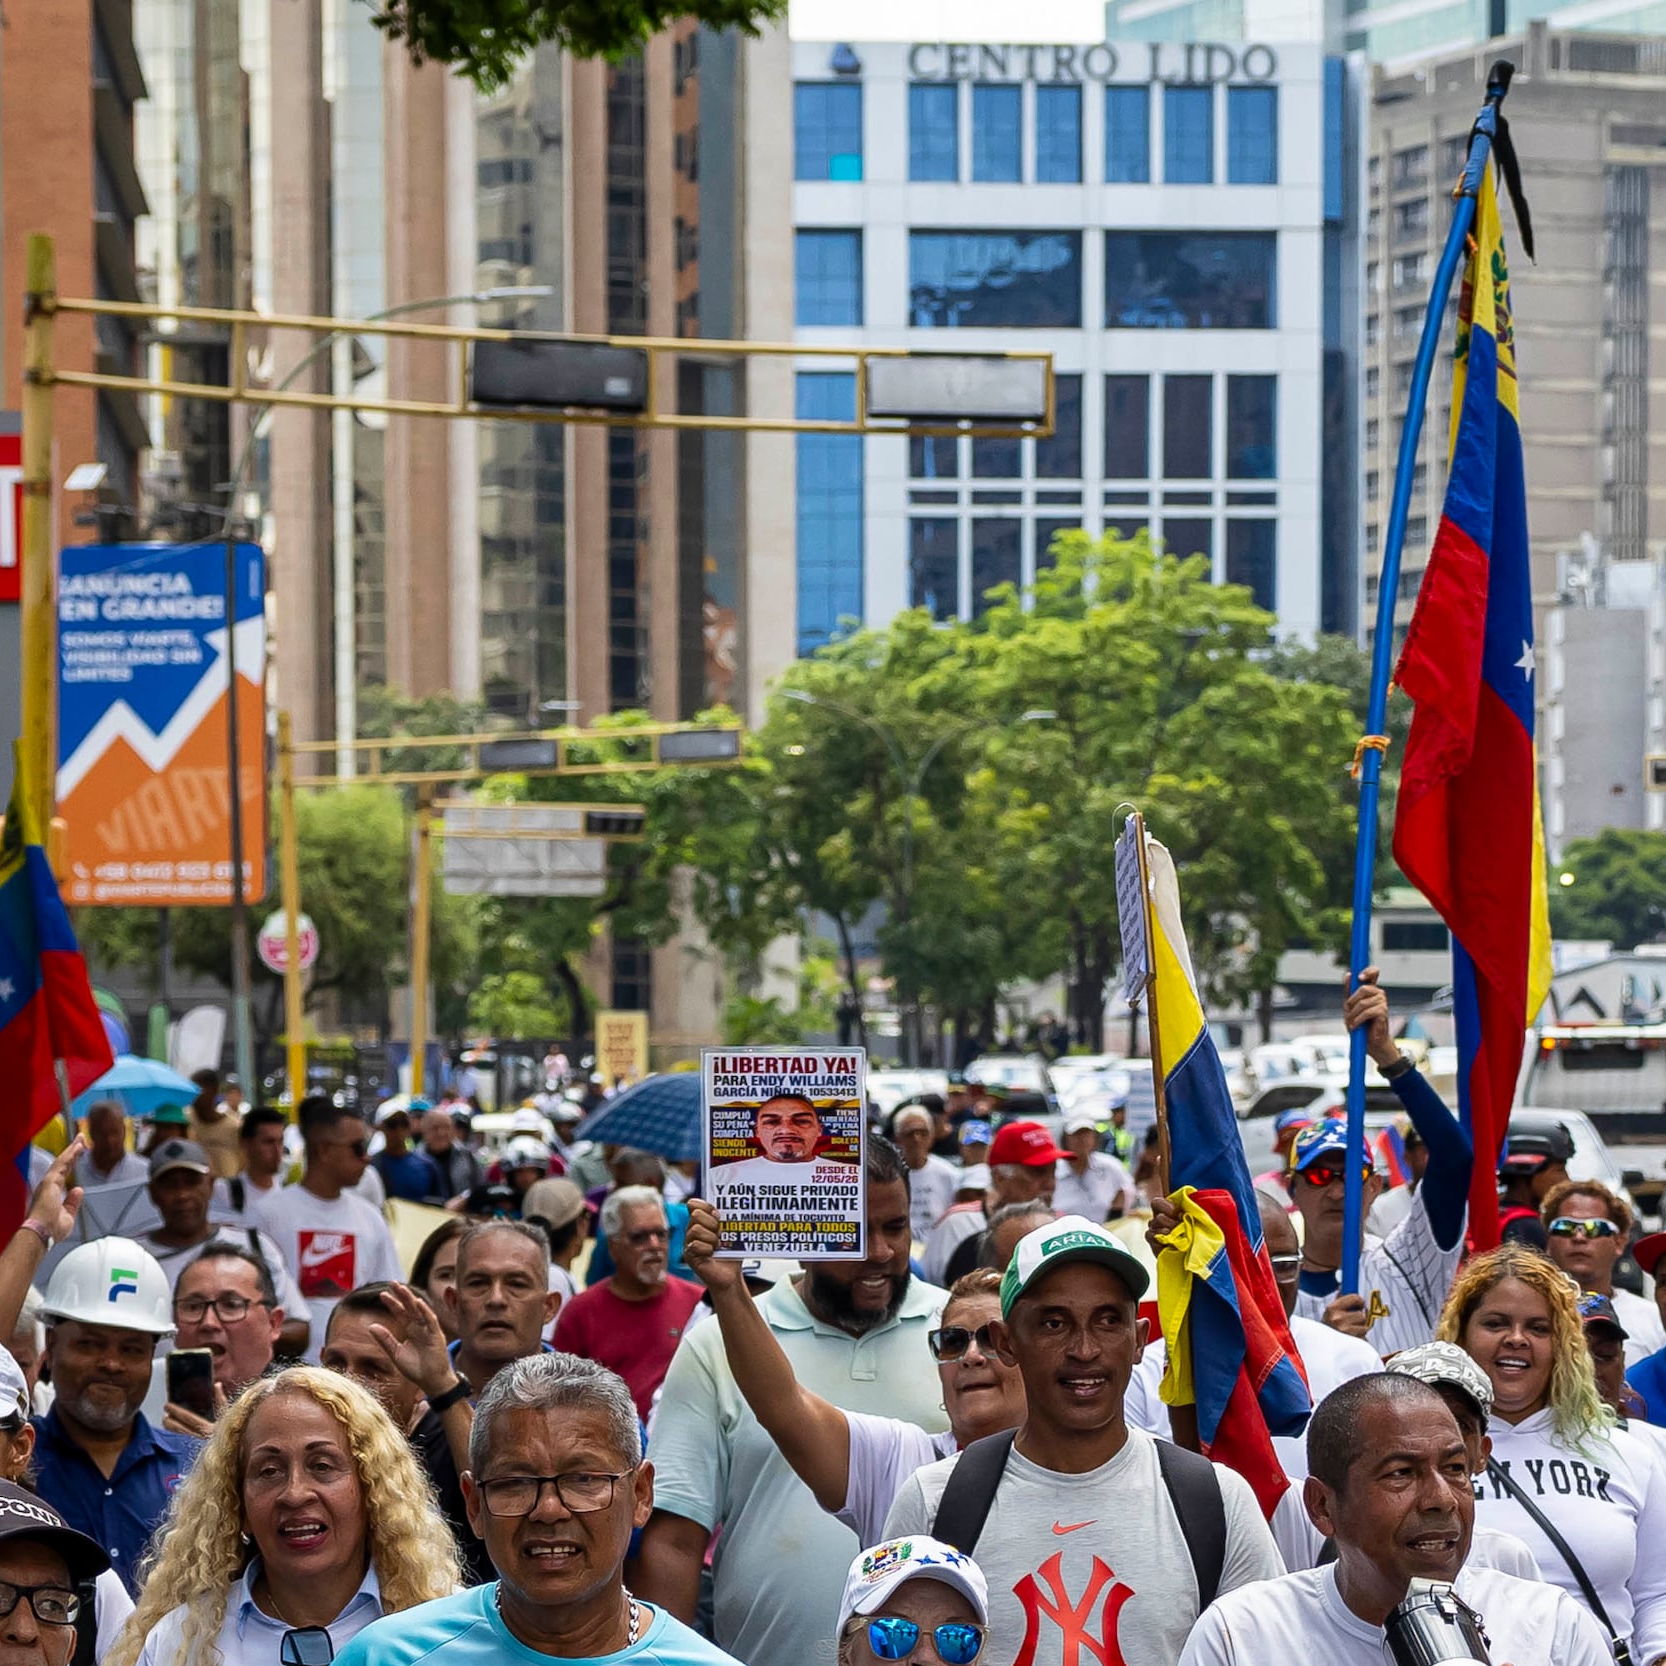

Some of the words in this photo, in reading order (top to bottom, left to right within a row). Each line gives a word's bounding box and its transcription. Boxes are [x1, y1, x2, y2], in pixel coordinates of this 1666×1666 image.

[908, 43, 1118, 82] CENTRO
[1148, 44, 1278, 85] LIDO
[59, 597, 98, 621] EN
[101, 595, 225, 621] GRANDE!
[95, 766, 256, 852] VIARTE
[713, 1057, 817, 1074] ¡LIBERTAD
[823, 1057, 856, 1074] YA!
[713, 1075, 748, 1086] PARA
[751, 1075, 788, 1086] ENDY
[789, 1075, 857, 1086] WILLIAMS
[713, 1085, 757, 1097] GARCÍA
[713, 1110, 751, 1120] CUMPLIÓ
[713, 1120, 724, 1129] SU
[713, 1129, 754, 1138] COMPLETA
[713, 1139, 746, 1148] SIENDO
[713, 1148, 757, 1157] INOCENTE
[816, 1166, 846, 1174] DESDE
[848, 1166, 858, 1174] EL
[716, 1185, 725, 1195] Y
[728, 1183, 753, 1195] AÚN
[759, 1185, 797, 1196] SIGUE
[801, 1185, 858, 1196] PRIVADO
[716, 1195, 858, 1211] ILEGÍTIMAMENTE
[726, 1213, 738, 1221] LA
[741, 1212, 779, 1221] MÍNIMA
[784, 1213, 796, 1221] DE
[798, 1213, 846, 1221] TOCUYITO
[720, 1222, 776, 1232] LIBERTAD
[780, 1222, 812, 1232] PARA
[816, 1222, 856, 1232] TODOS
[721, 1232, 737, 1242] OS
[740, 1232, 787, 1242] PRESOS
[790, 1231, 857, 1243] POLÍTICOS!
[743, 1242, 827, 1252] VENEZUELA
[1471, 1461, 1514, 1500] EW
[1525, 1459, 1615, 1503] YORK
